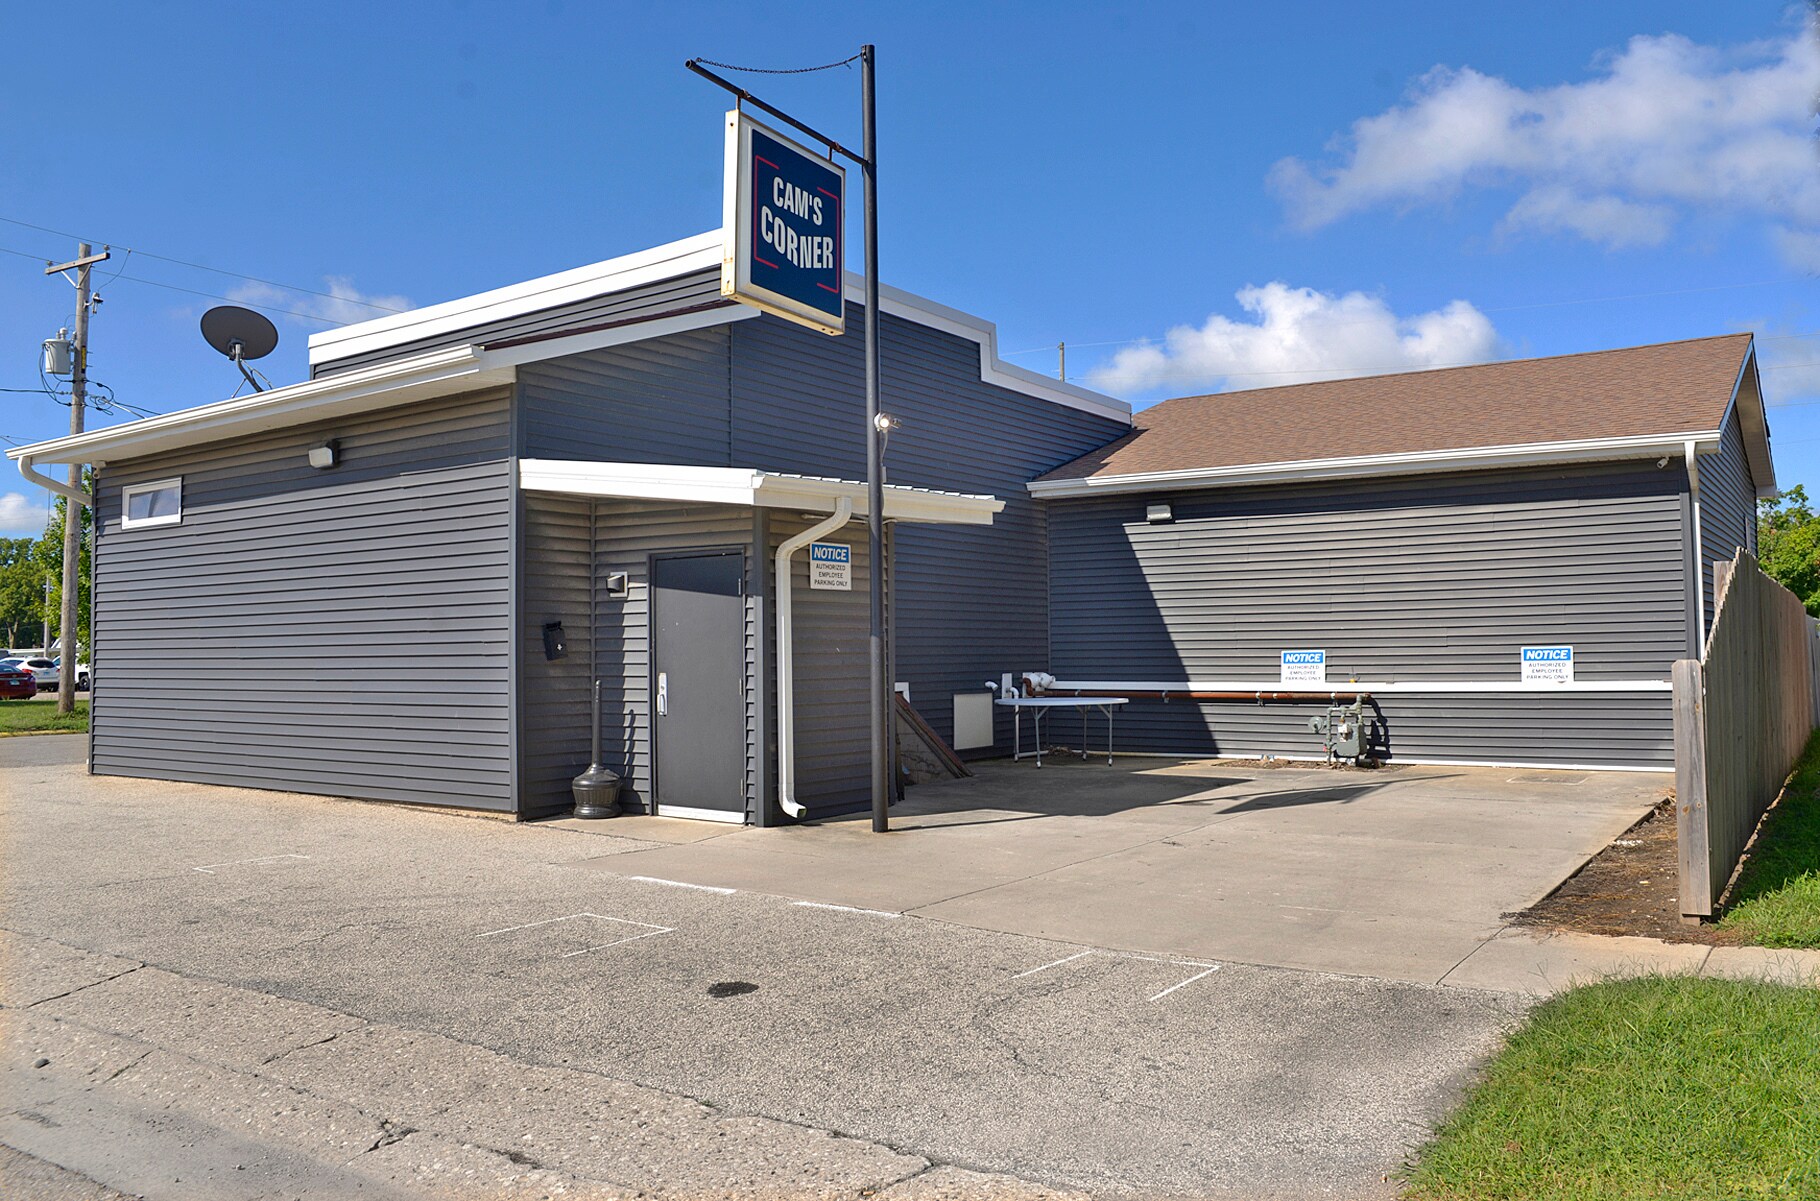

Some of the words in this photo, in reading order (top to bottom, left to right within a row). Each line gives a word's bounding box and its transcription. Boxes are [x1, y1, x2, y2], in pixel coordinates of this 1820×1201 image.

[773, 176, 823, 226] CAM'S
[761, 205, 834, 269] CORNER
[814, 547, 847, 560] NOTICE
[816, 563, 846, 571] AUTHORIZED
[818, 571, 844, 579] EMPLOYEE
[814, 579, 835, 587] PARKING
[1285, 653, 1321, 663] NOTICE
[1526, 650, 1568, 660] NOTICE
